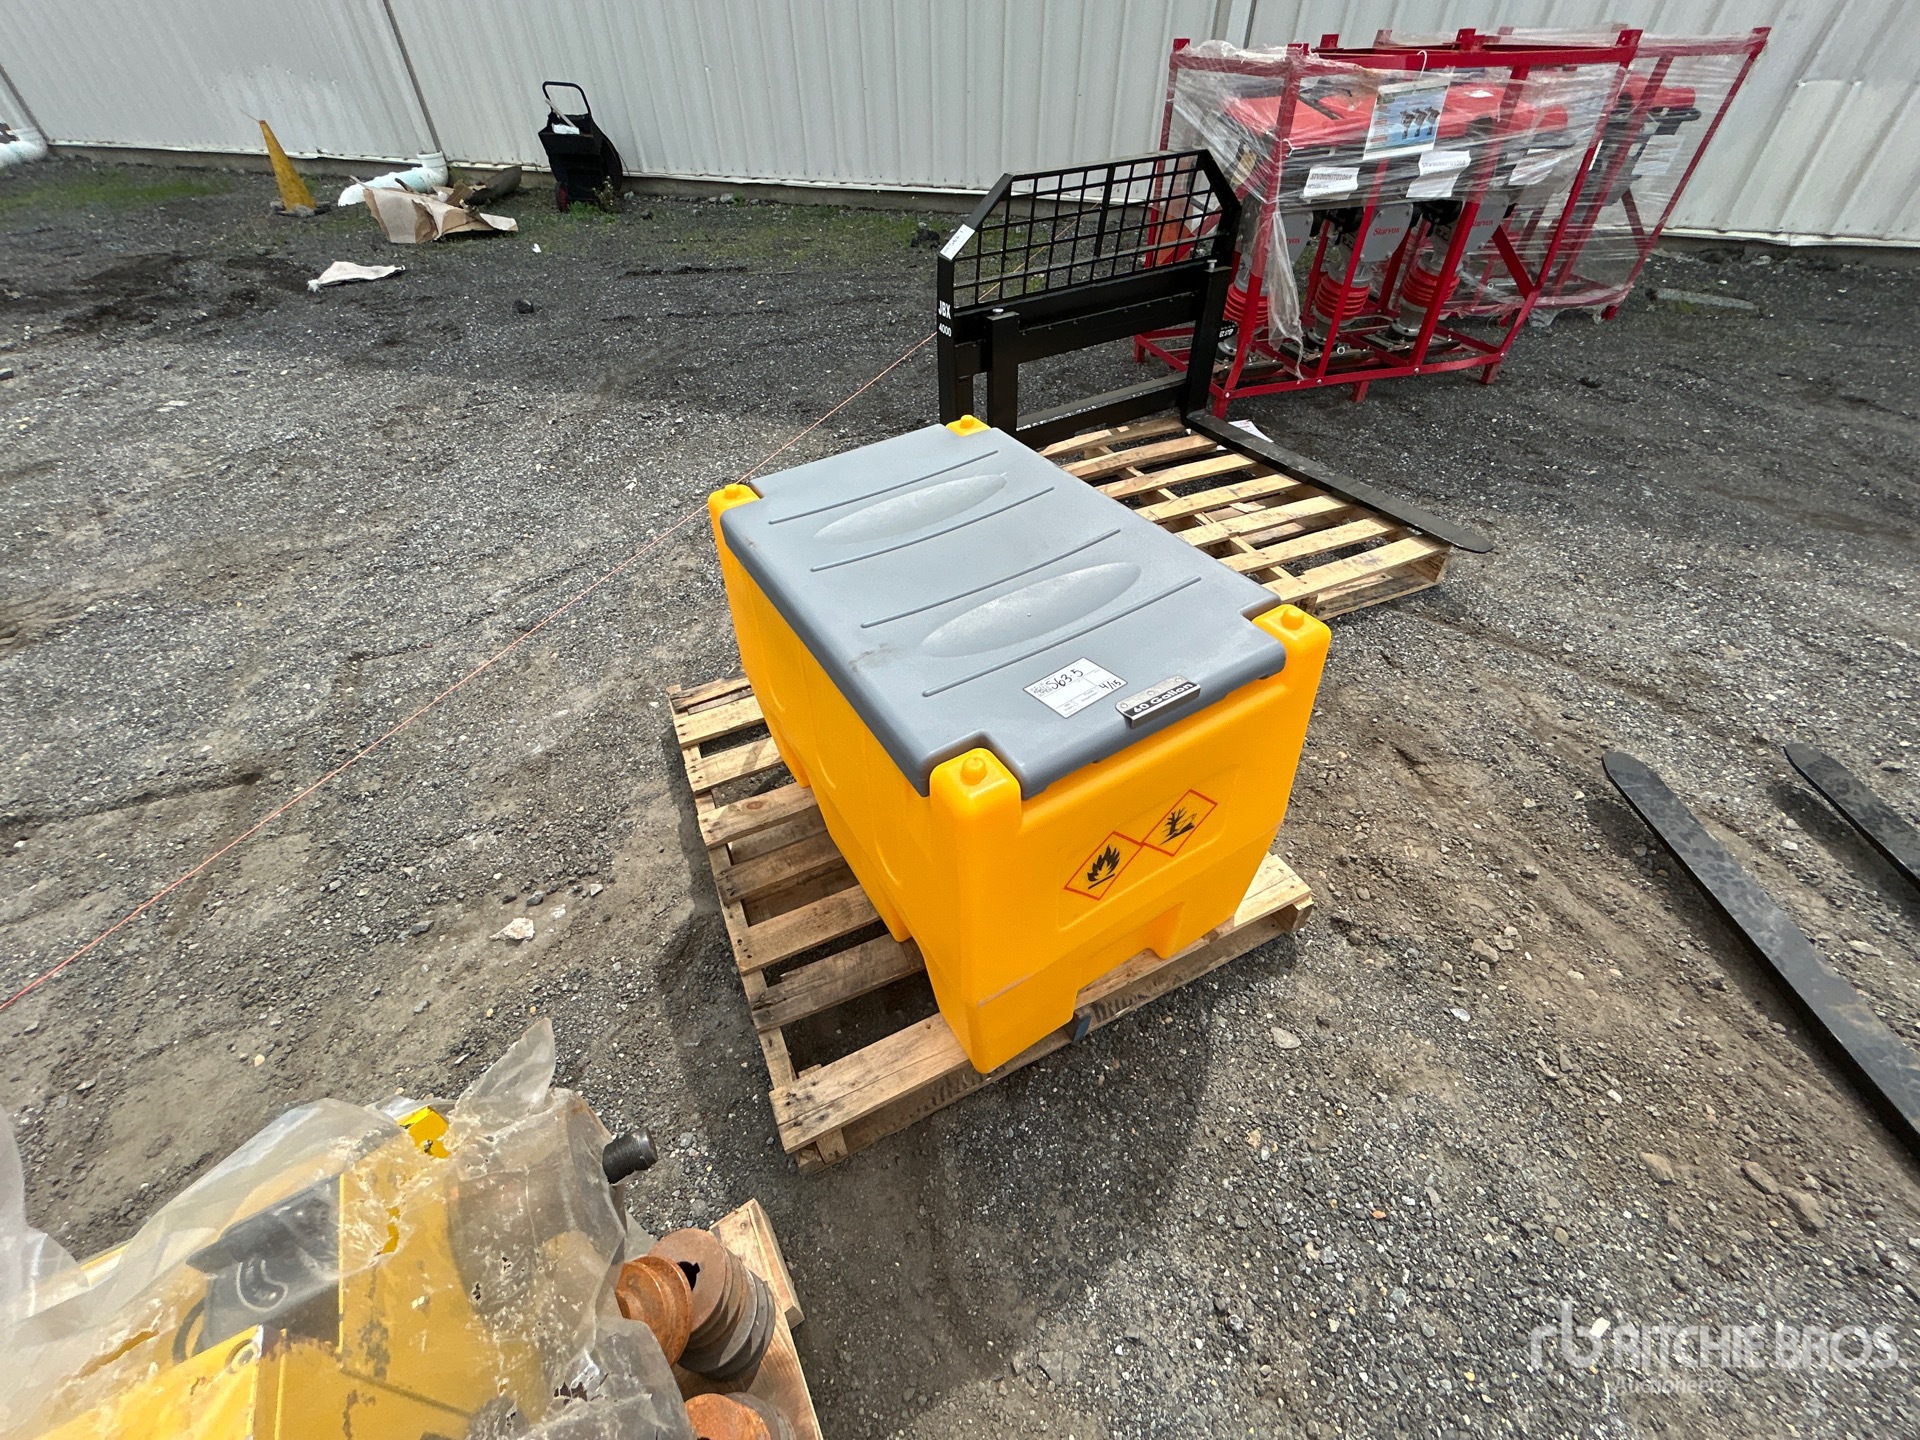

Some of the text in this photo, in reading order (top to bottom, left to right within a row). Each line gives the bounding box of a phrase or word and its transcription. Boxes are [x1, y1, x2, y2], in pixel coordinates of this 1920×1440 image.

[938, 300, 951, 319] JBX
[938, 323, 952, 337] 4000
[1098, 679, 1122, 690] 4/15
[1133, 683, 1194, 713] 60 Gallon
